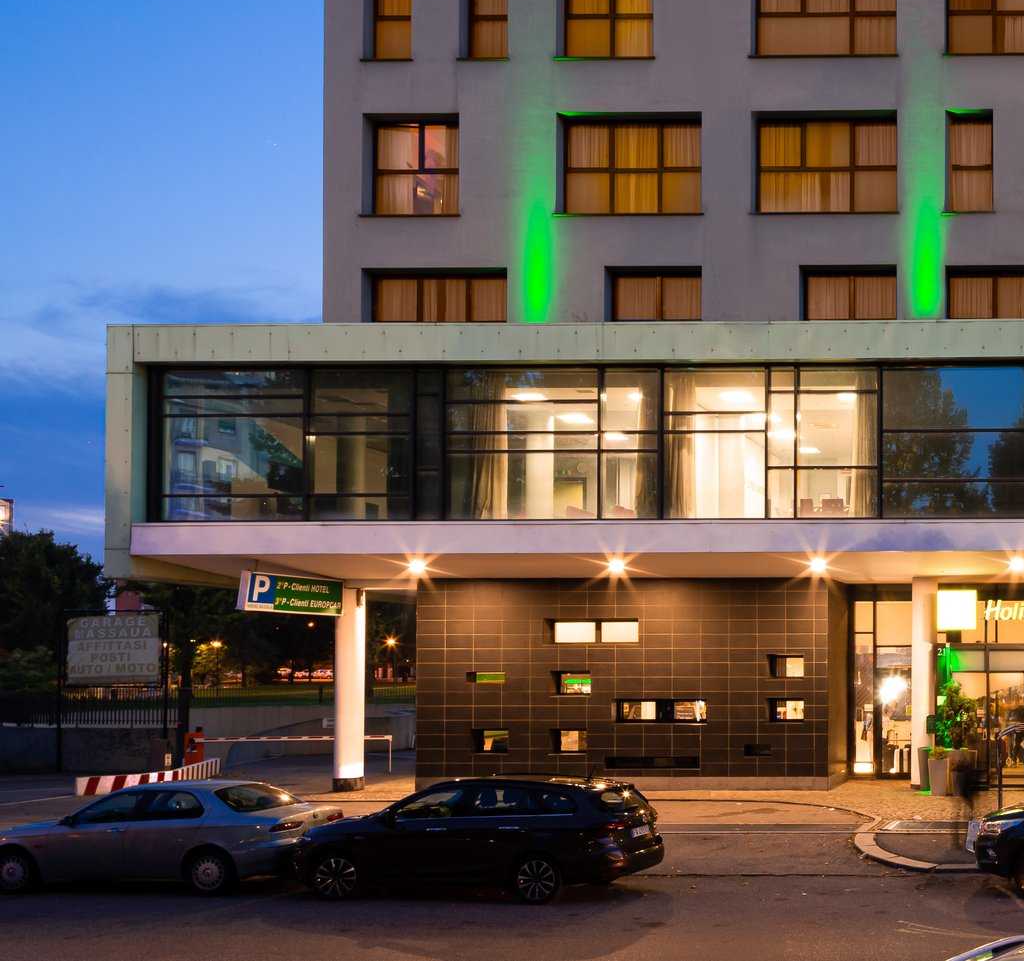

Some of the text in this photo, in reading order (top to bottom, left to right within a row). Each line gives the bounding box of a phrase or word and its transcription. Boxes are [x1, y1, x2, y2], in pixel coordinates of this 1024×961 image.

[252, 575, 271, 601] P
[310, 584, 330, 594] HOTEL
[90, 651, 132, 663] POSTI
